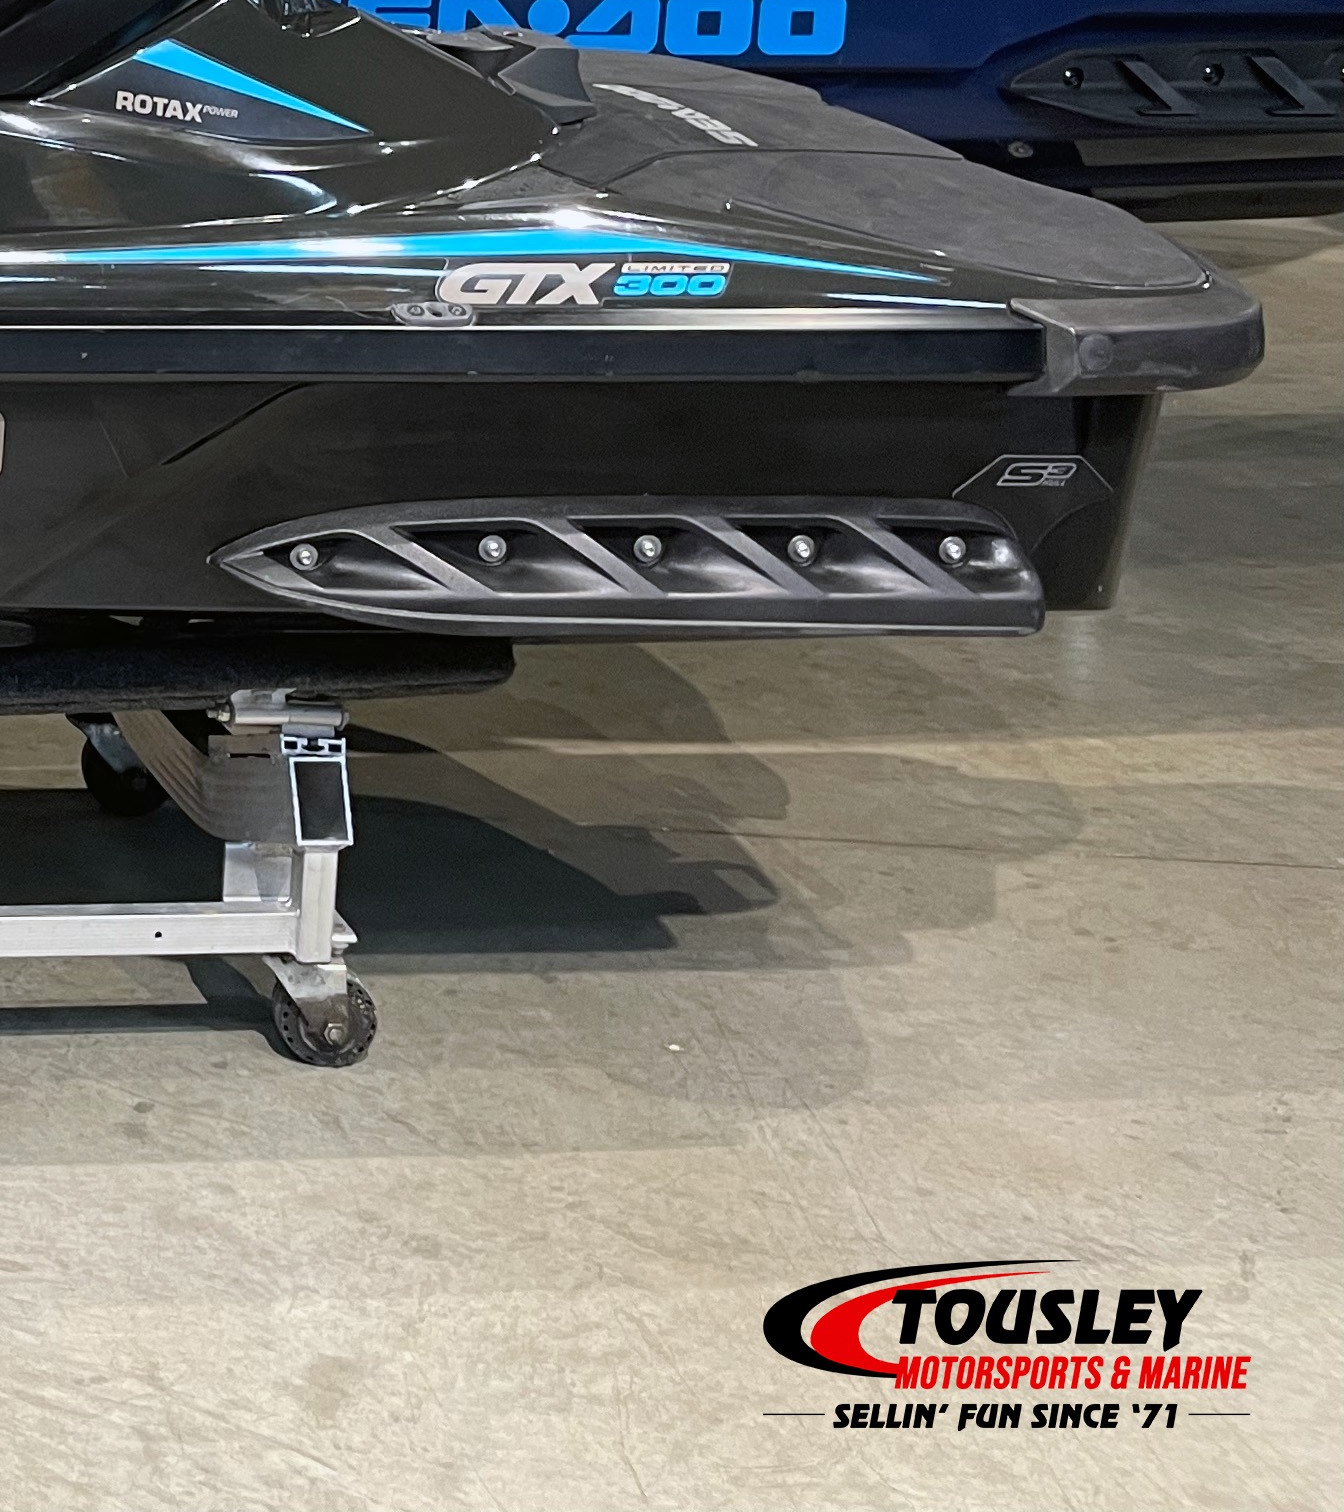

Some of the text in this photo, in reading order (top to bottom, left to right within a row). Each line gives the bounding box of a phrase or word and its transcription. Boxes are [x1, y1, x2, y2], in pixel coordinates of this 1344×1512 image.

[115, 90, 239, 123] ROTAX POWER
[439, 262, 725, 305] GTX LIMITED
[613, 274, 727, 296] 300
